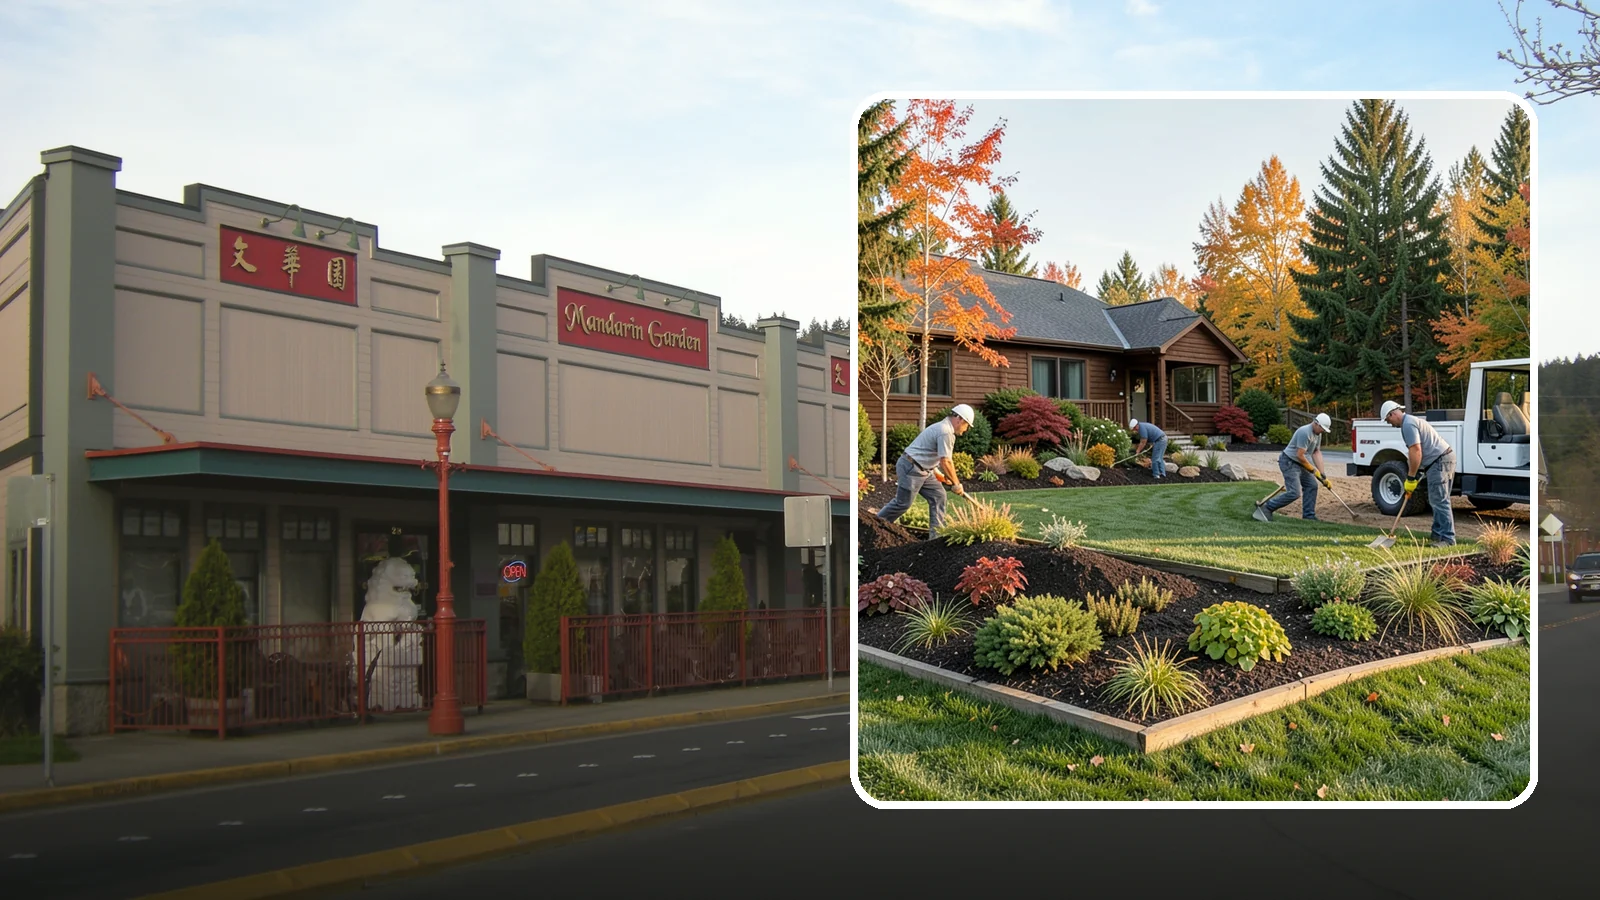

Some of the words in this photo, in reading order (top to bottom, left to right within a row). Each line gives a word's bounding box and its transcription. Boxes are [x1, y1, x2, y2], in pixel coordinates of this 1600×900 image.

[564, 302, 644, 341] Mandarin
[648, 320, 702, 352] Garden
[503, 565, 527, 578] OPEN
